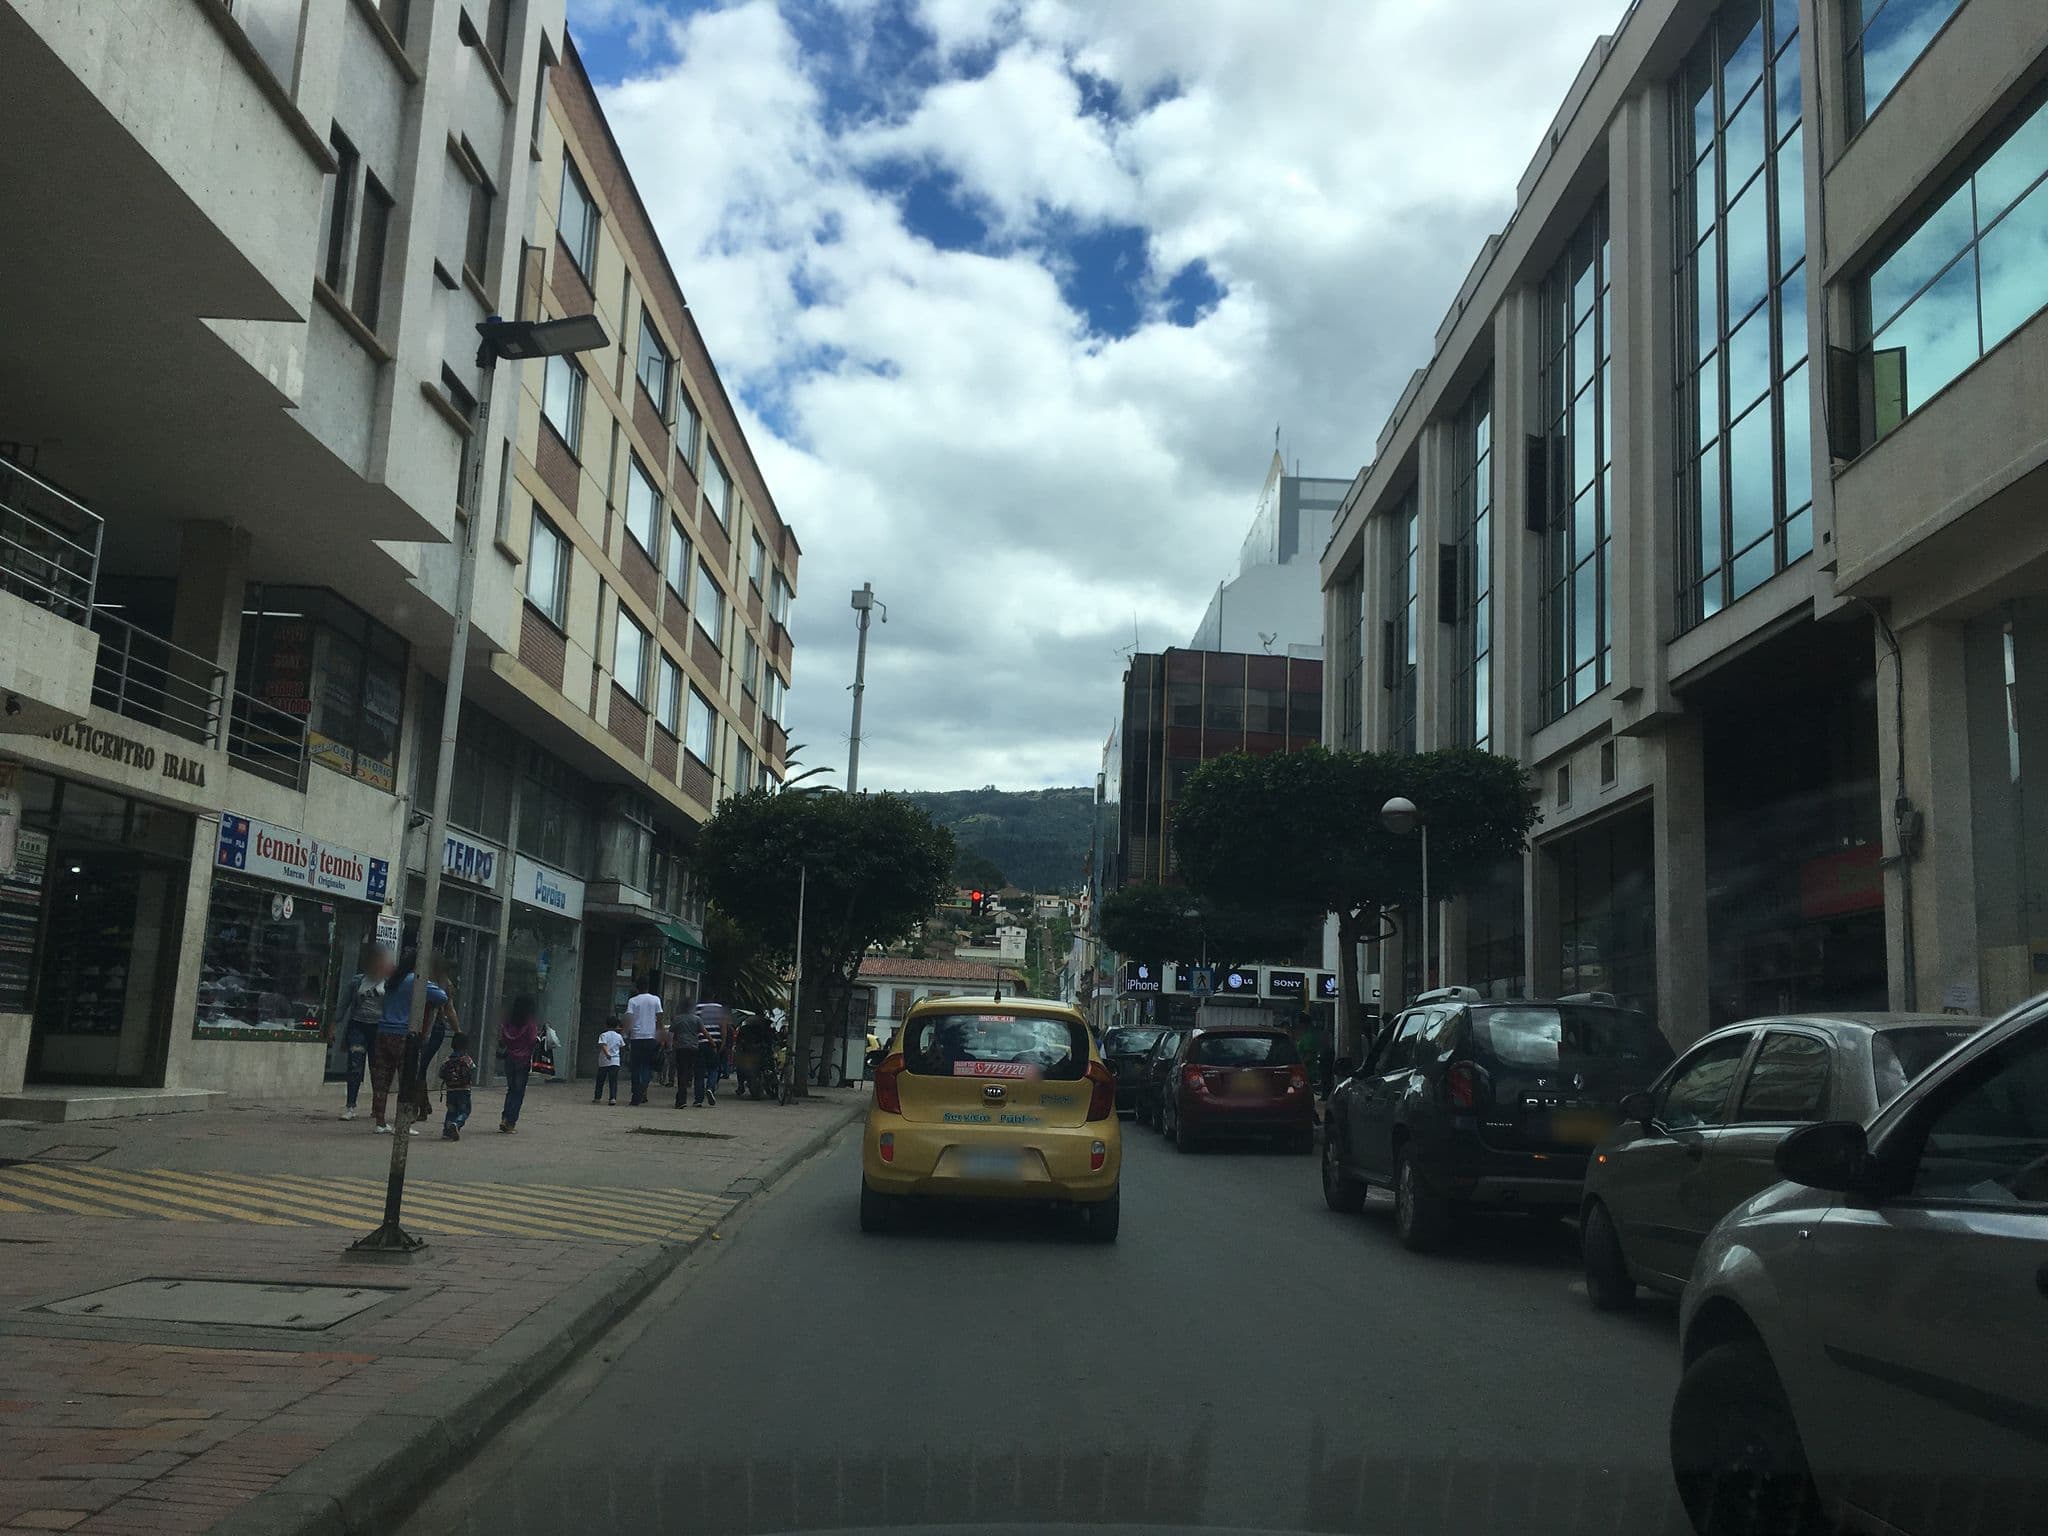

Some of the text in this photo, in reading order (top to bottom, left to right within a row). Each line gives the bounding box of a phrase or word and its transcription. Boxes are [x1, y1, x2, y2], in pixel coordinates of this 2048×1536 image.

[163, 753, 205, 787] IRAKA
[256, 829, 308, 868] tennis
[320, 848, 363, 882] tennis
[283, 867, 346, 890] Marcas Originales
[1127, 978, 1159, 991] iPhone
[1273, 979, 1302, 988] SONY
